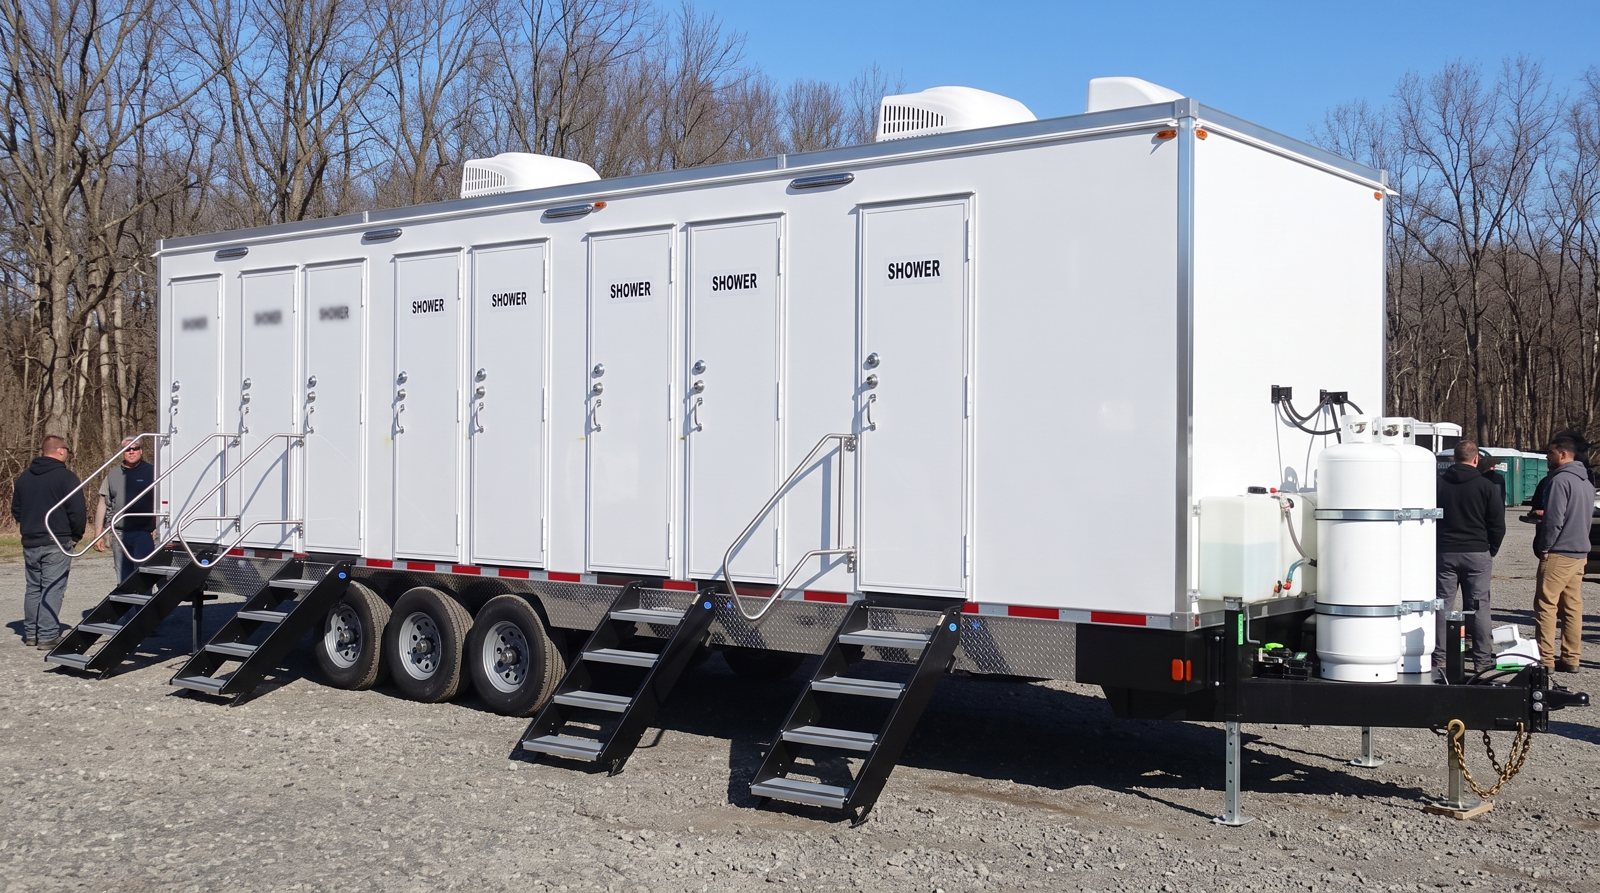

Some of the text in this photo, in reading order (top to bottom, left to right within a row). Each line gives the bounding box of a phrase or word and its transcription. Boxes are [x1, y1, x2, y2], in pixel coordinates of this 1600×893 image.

[887, 259, 941, 280] SHOWER
[610, 281, 652, 299] SHOWER
[712, 272, 758, 292] SHOWER
[411, 298, 445, 315] SHOWER
[491, 291, 527, 308] SHOWER
[319, 304, 349, 320] OWER
